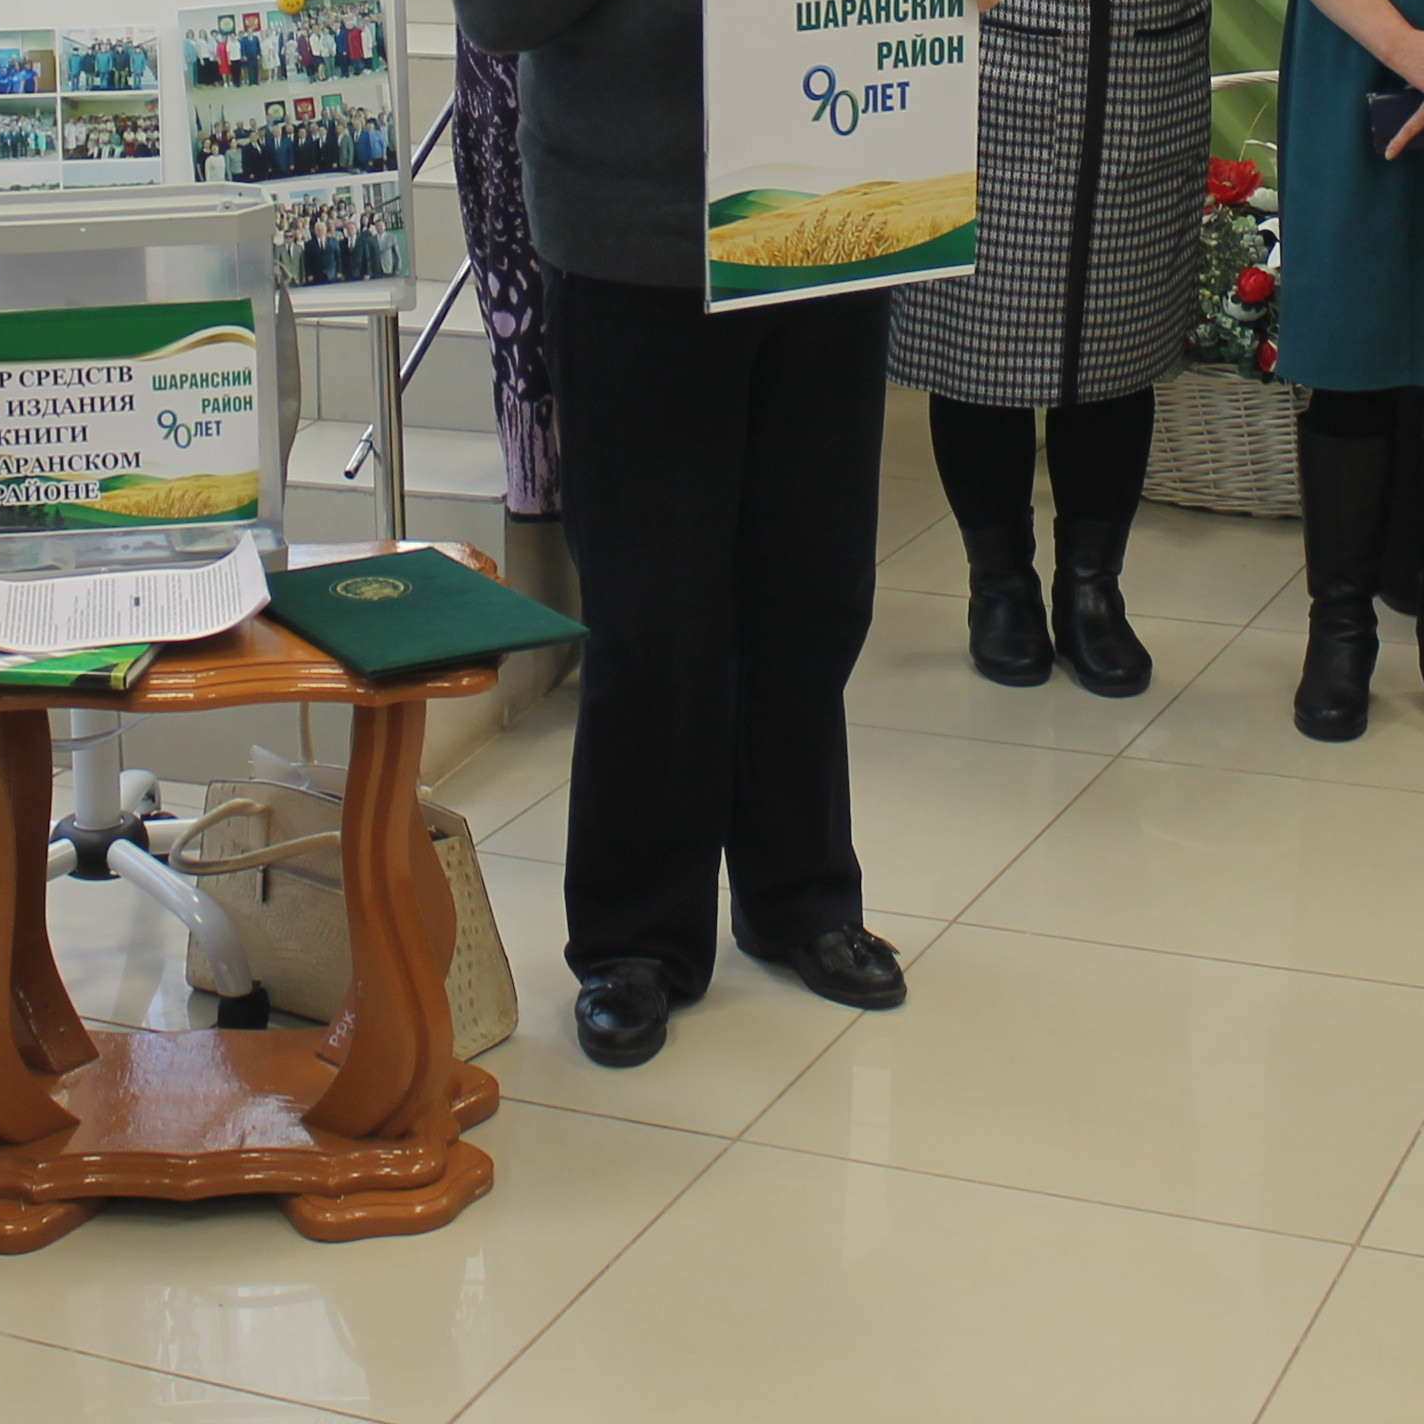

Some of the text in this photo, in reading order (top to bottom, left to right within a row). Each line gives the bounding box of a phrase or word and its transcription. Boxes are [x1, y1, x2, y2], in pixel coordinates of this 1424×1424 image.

[877, 33, 965, 70] РАЙОН
[802, 64, 911, 136] 90 ЛЕТ
[18, 364, 134, 389] СРЕДСТВ
[152, 366, 252, 391] ШАРАНСКИЙ
[6, 394, 136, 420] ИЗДАНИЯ
[201, 394, 253, 414] РАЙОН
[157, 409, 222, 449] 90 ЛЕТ
